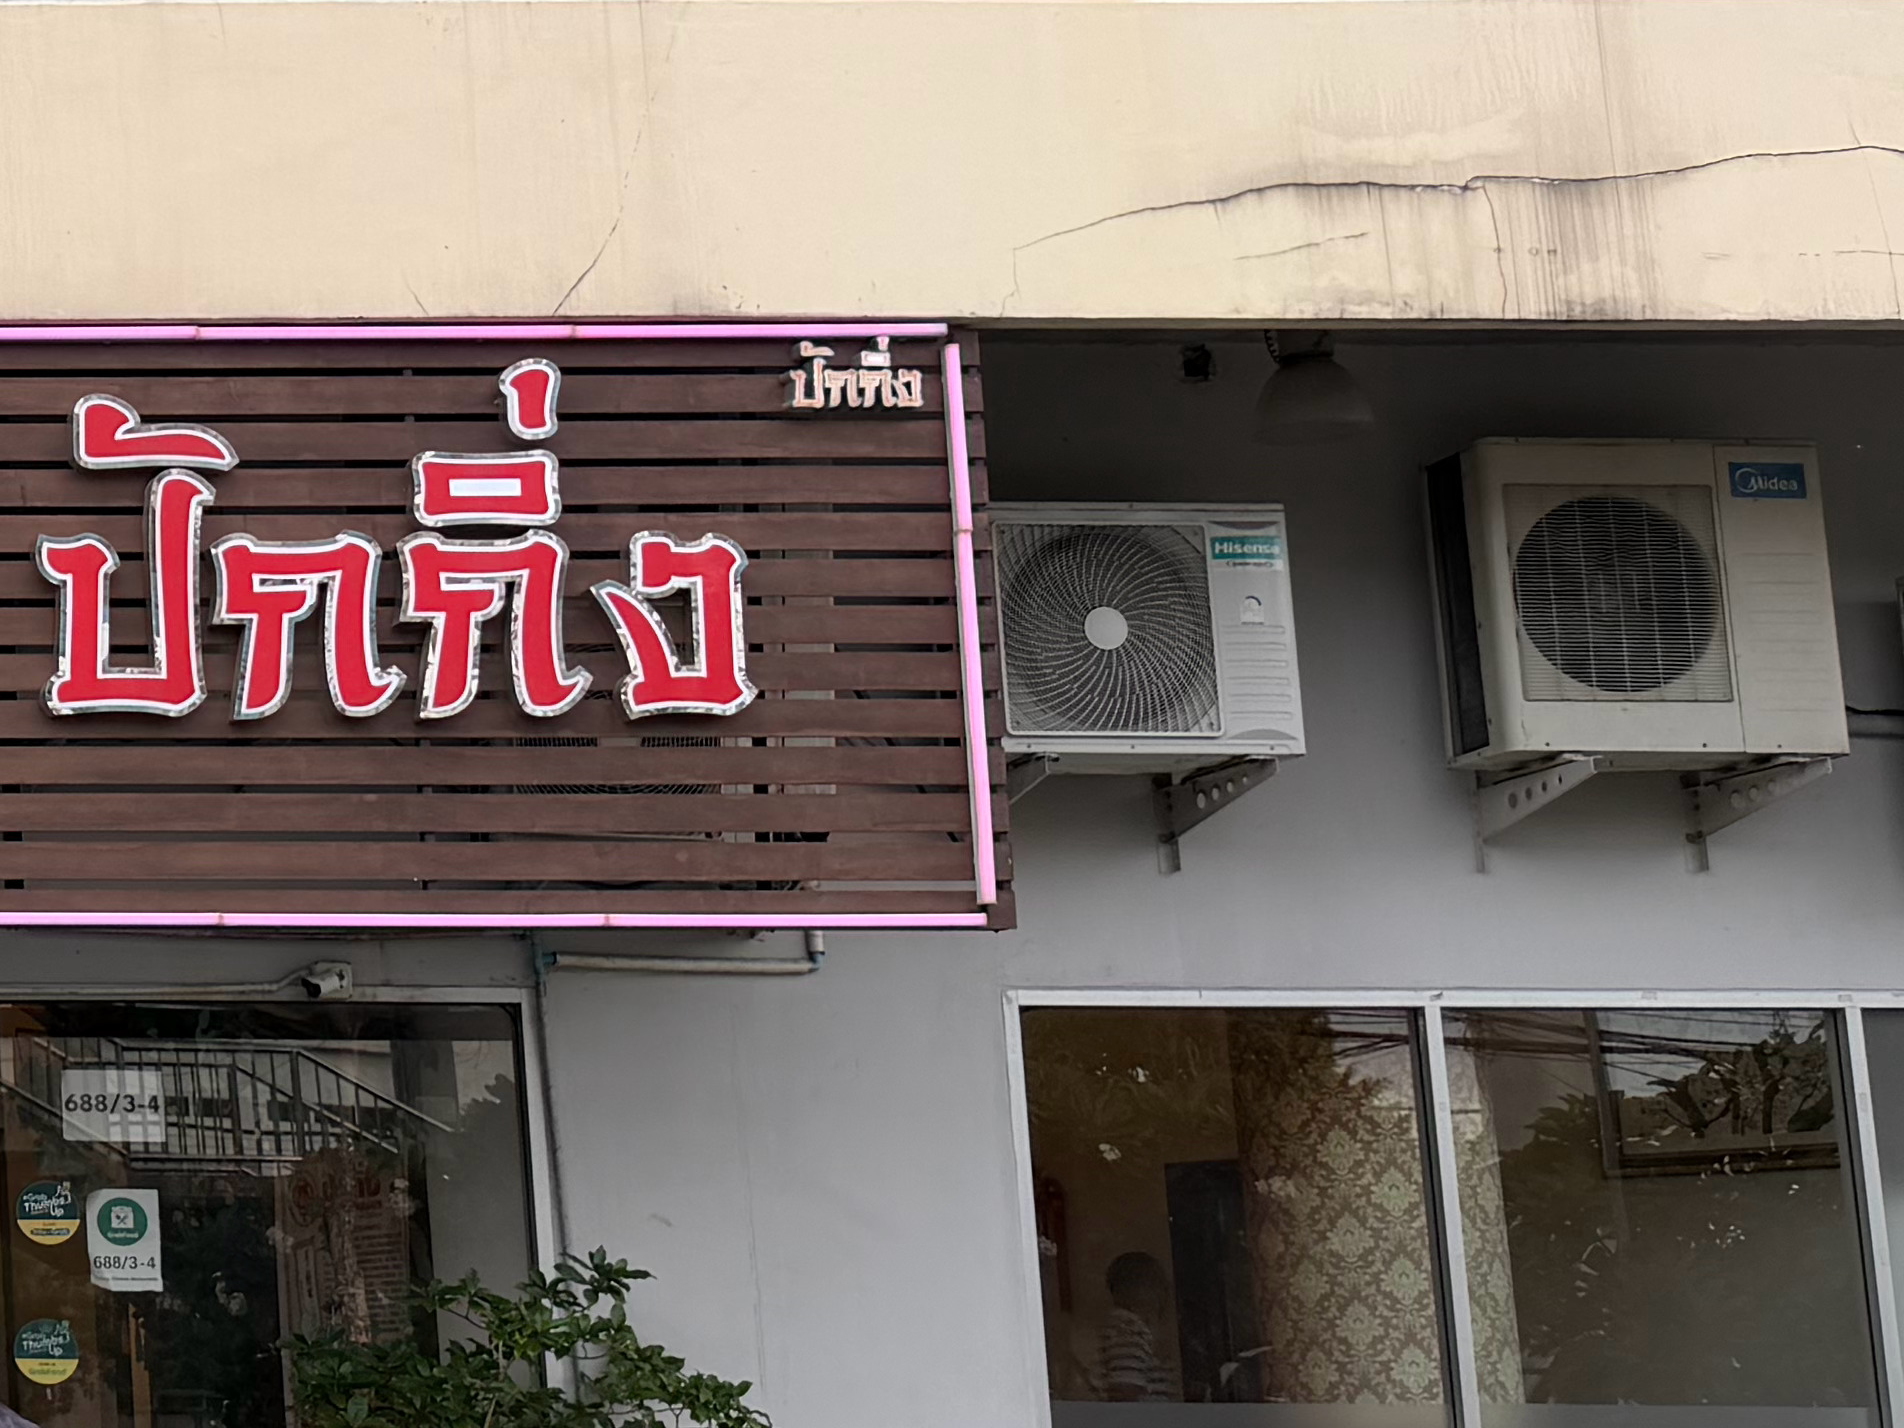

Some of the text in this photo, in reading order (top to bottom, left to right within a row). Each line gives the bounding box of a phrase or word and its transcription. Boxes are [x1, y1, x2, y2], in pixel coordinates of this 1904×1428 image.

[1740, 472, 1799, 492] Midea
[35, 358, 757, 721] ปักกิ่ง
[1214, 541, 1282, 555] Hisense
[63, 1092, 160, 1114] 688/3-4
[93, 1255, 157, 1270] 688/3-4
